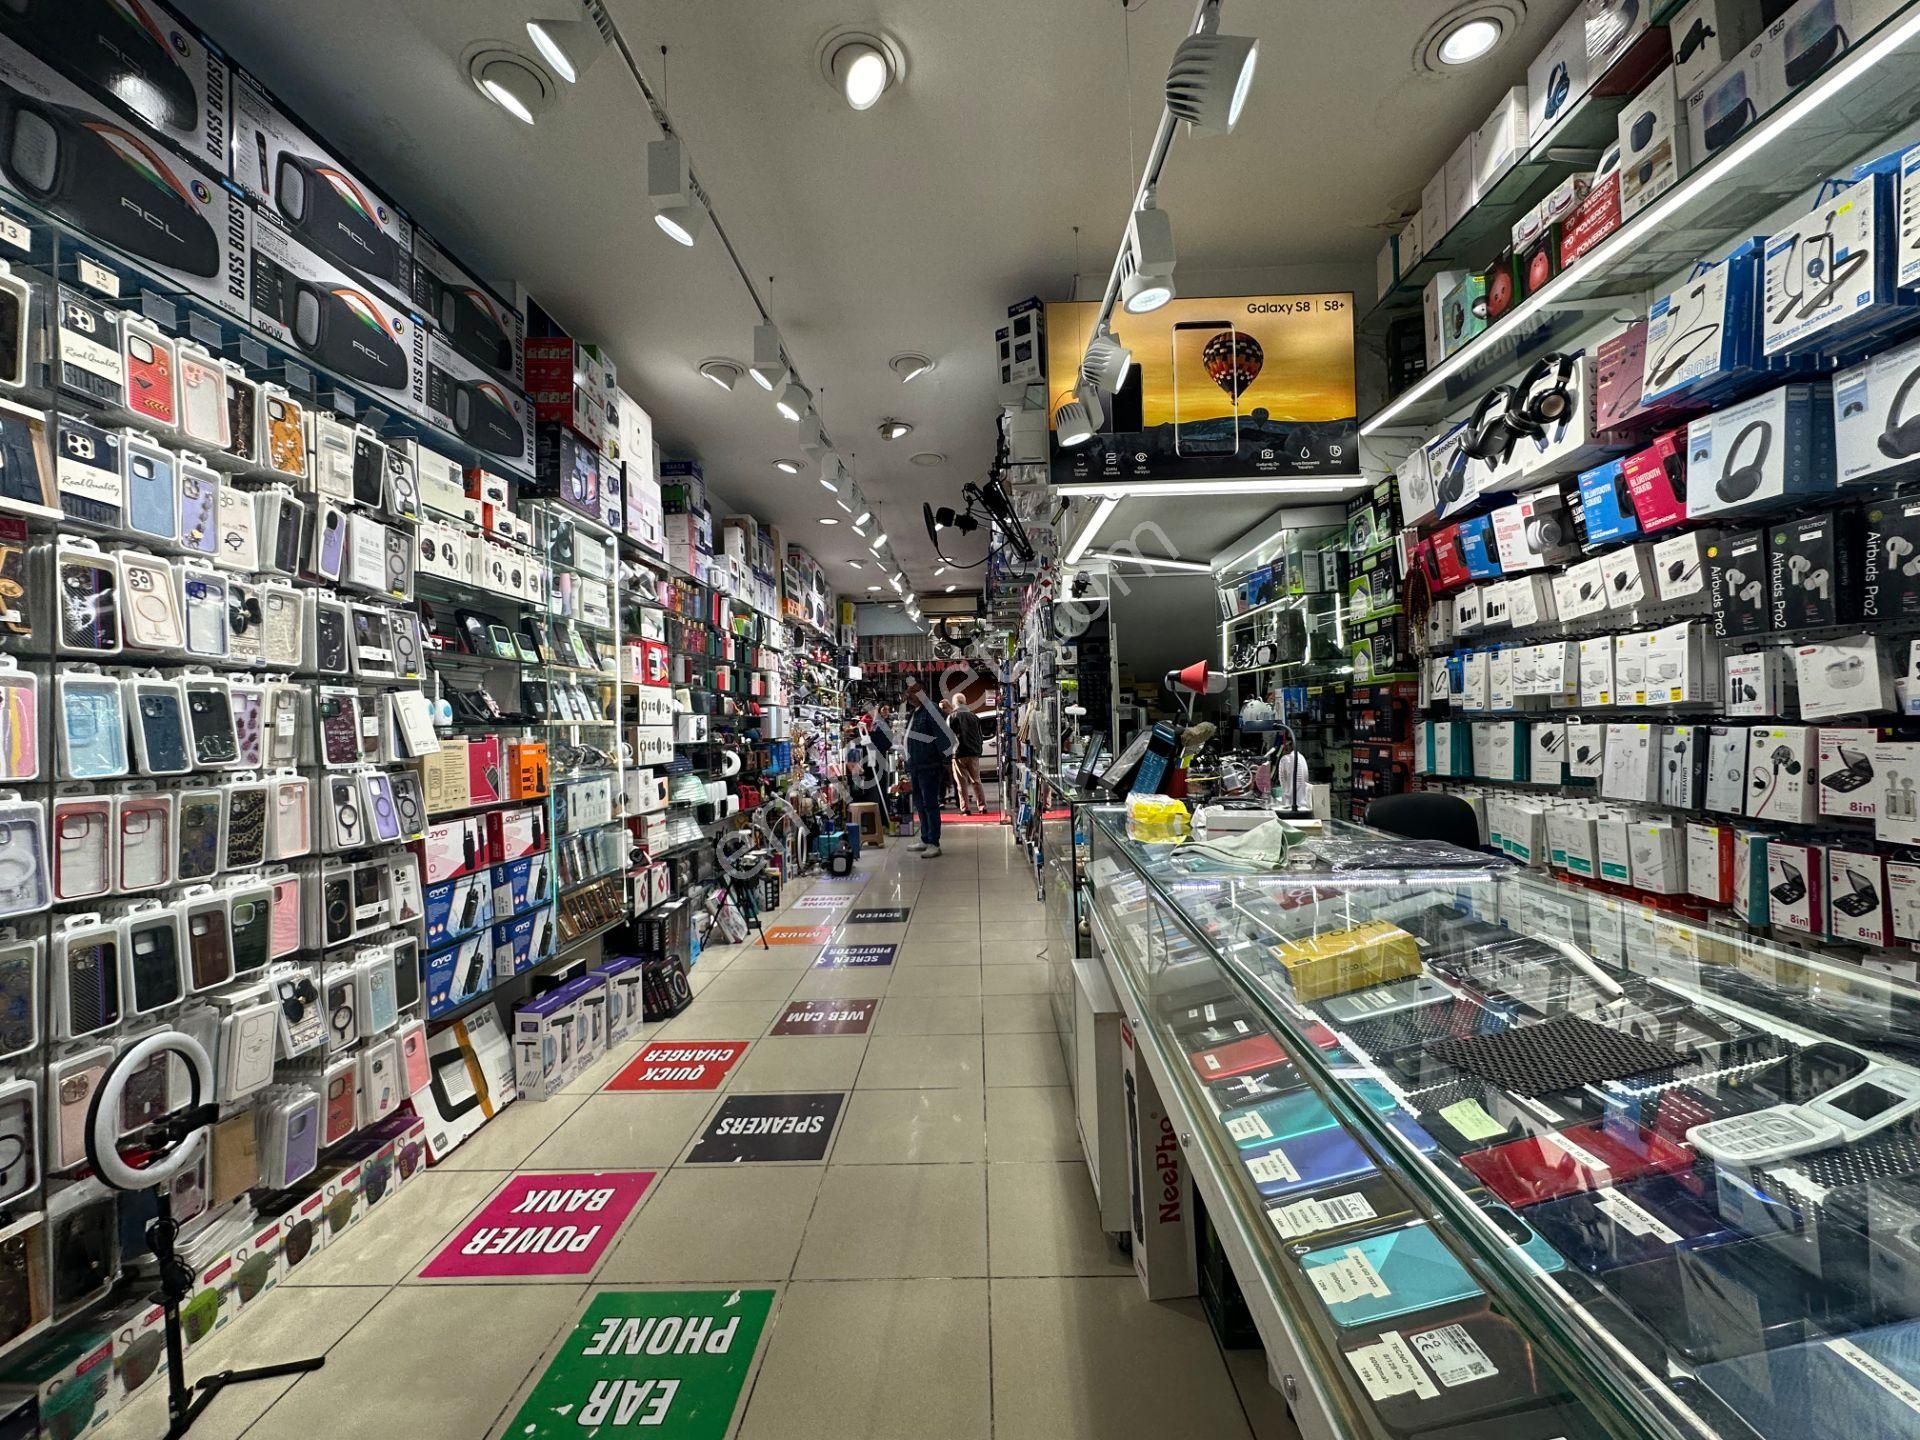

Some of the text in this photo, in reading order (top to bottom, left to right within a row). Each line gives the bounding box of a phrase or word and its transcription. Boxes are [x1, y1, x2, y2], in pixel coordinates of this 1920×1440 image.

[206, 52, 223, 160] BASS BOOST
[121, 197, 185, 243] ACL
[229, 194, 245, 254] BOOST
[257, 205, 292, 232] ACL
[1575, 197, 1613, 236] POWERDEX
[338, 222, 375, 255] ACL
[1576, 218, 1615, 256] POWERDEX
[229, 254, 245, 300] BASS
[1247, 300, 1345, 315] Galaxy S8 S8+
[1802, 303, 1844, 329] NECKBAND
[258, 319, 284, 341] 100W
[88, 352, 121, 374] Quality
[352, 340, 389, 367] ACL
[413, 323, 424, 403] BASS BOOST
[527, 403, 535, 466] BASS BOOST
[86, 478, 120, 497] Quality
[1584, 483, 1612, 498] BLUETOOTH
[1630, 468, 1661, 488] BLUETOOTH
[1633, 482, 1652, 496] SOUND
[1645, 513, 1677, 529] HEADPHONE
[1864, 532, 1880, 616] Airbuds Pro2
[1710, 566, 1727, 637] Airbuds Pro2
[1772, 552, 1787, 628] Airbuds Pro2
[1618, 693, 1634, 701] 20W
[1849, 802, 1876, 813] 8in1
[1790, 914, 1808, 927] 8in1
[1858, 927, 1881, 941] 8in1
[833, 955, 879, 963] SCREEN
[786, 1010, 865, 1022] WEB CAM
[291, 1031, 322, 1048] SHOCK
[644, 1049, 734, 1062] CHARGER
[639, 1066, 706, 1081] QUICK
[716, 1115, 825, 1135] SPEAKERS
[511, 1188, 616, 1213] BANK
[1608, 1193, 1665, 1236] SAMSUNG A20
[461, 1225, 602, 1254] POWER
[582, 1316, 742, 1355] PHONE
[1391, 1342, 1410, 1364] TECNO
[1407, 1364, 1419, 1381] Pova
[1845, 1351, 1901, 1390] SAMSUNG
[577, 1379, 681, 1426] EAR
